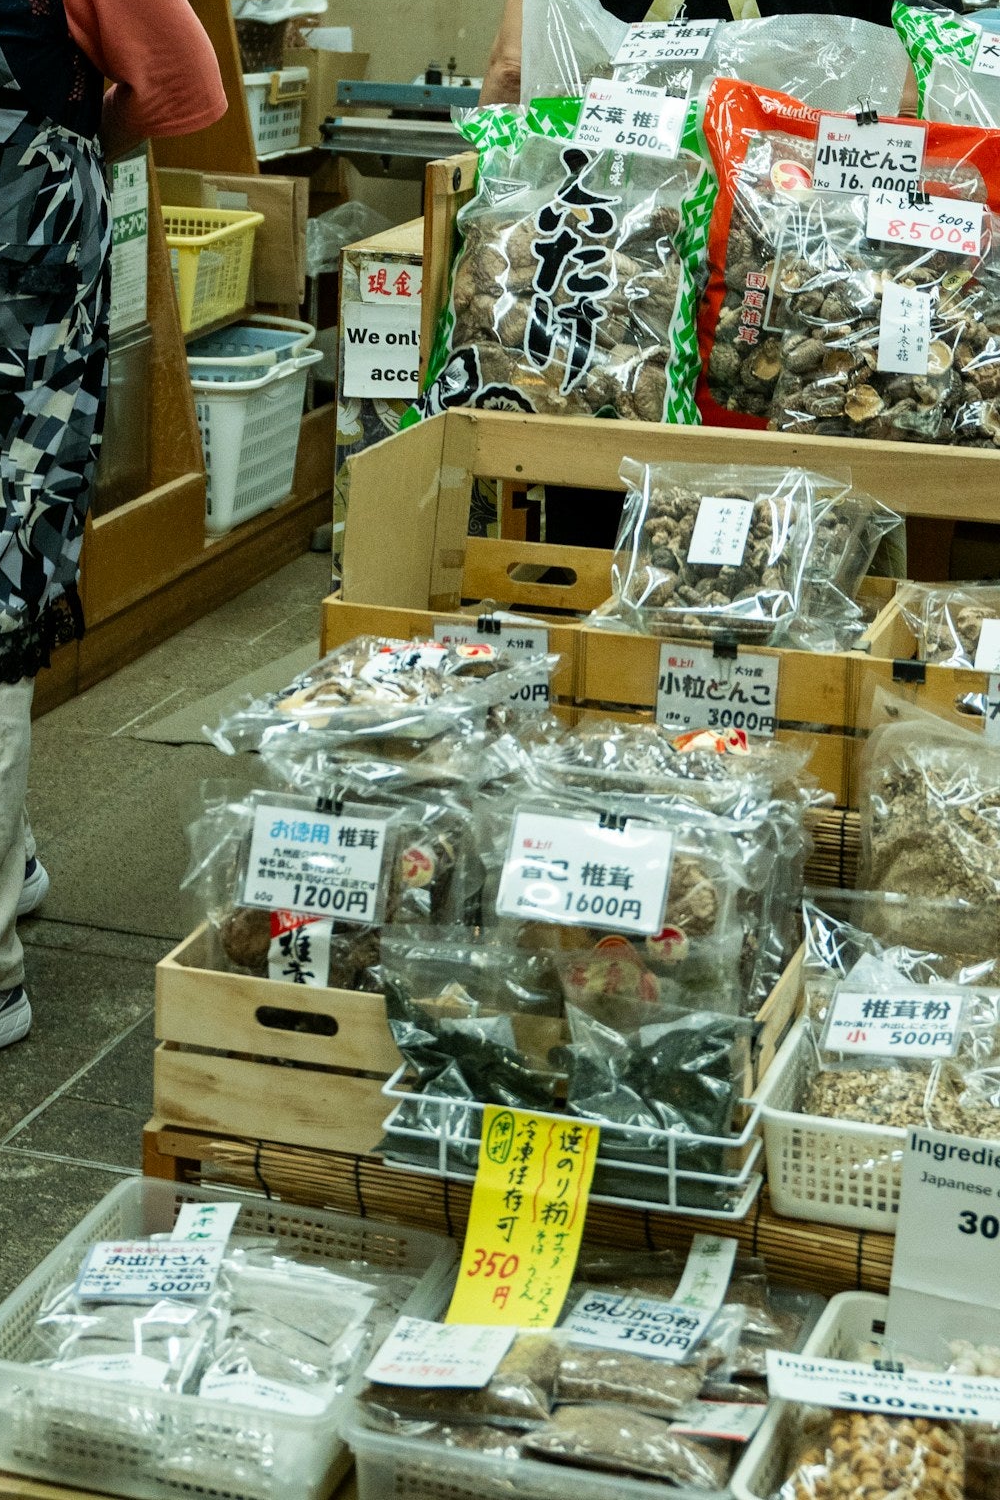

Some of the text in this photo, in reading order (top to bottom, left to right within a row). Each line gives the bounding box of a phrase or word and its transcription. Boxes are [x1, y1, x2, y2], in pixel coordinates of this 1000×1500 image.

[585, 104, 627, 125] 大葉
[886, 137, 913, 149] 大分産
[816, 144, 918, 174] 小粒どんこ
[737, 270, 768, 346] 国産椎茸
[346, 327, 380, 344] We
[734, 665, 764, 678] 大分産
[657, 671, 772, 706] 小粒どんこ
[707, 707, 776, 733] 3000円
[269, 819, 380, 851] お徳用 椎茸
[580, 861, 635, 892] 椎茸
[292, 883, 369, 914] 1200円
[563, 891, 643, 920] 1600円
[861, 998, 951, 1020] 椎茸粉
[846, 1029, 954, 1047] 小 500円
[539, 1126, 584, 1227] 焼のり粉
[920, 1170, 993, 1197] Japanese
[466, 1248, 520, 1280] 350
[147, 1280, 212, 1293] 500円
[491, 1285, 513, 1310] 円
[618, 1326, 692, 1351] 350円
[776, 1357, 920, 1384] Ingredients
